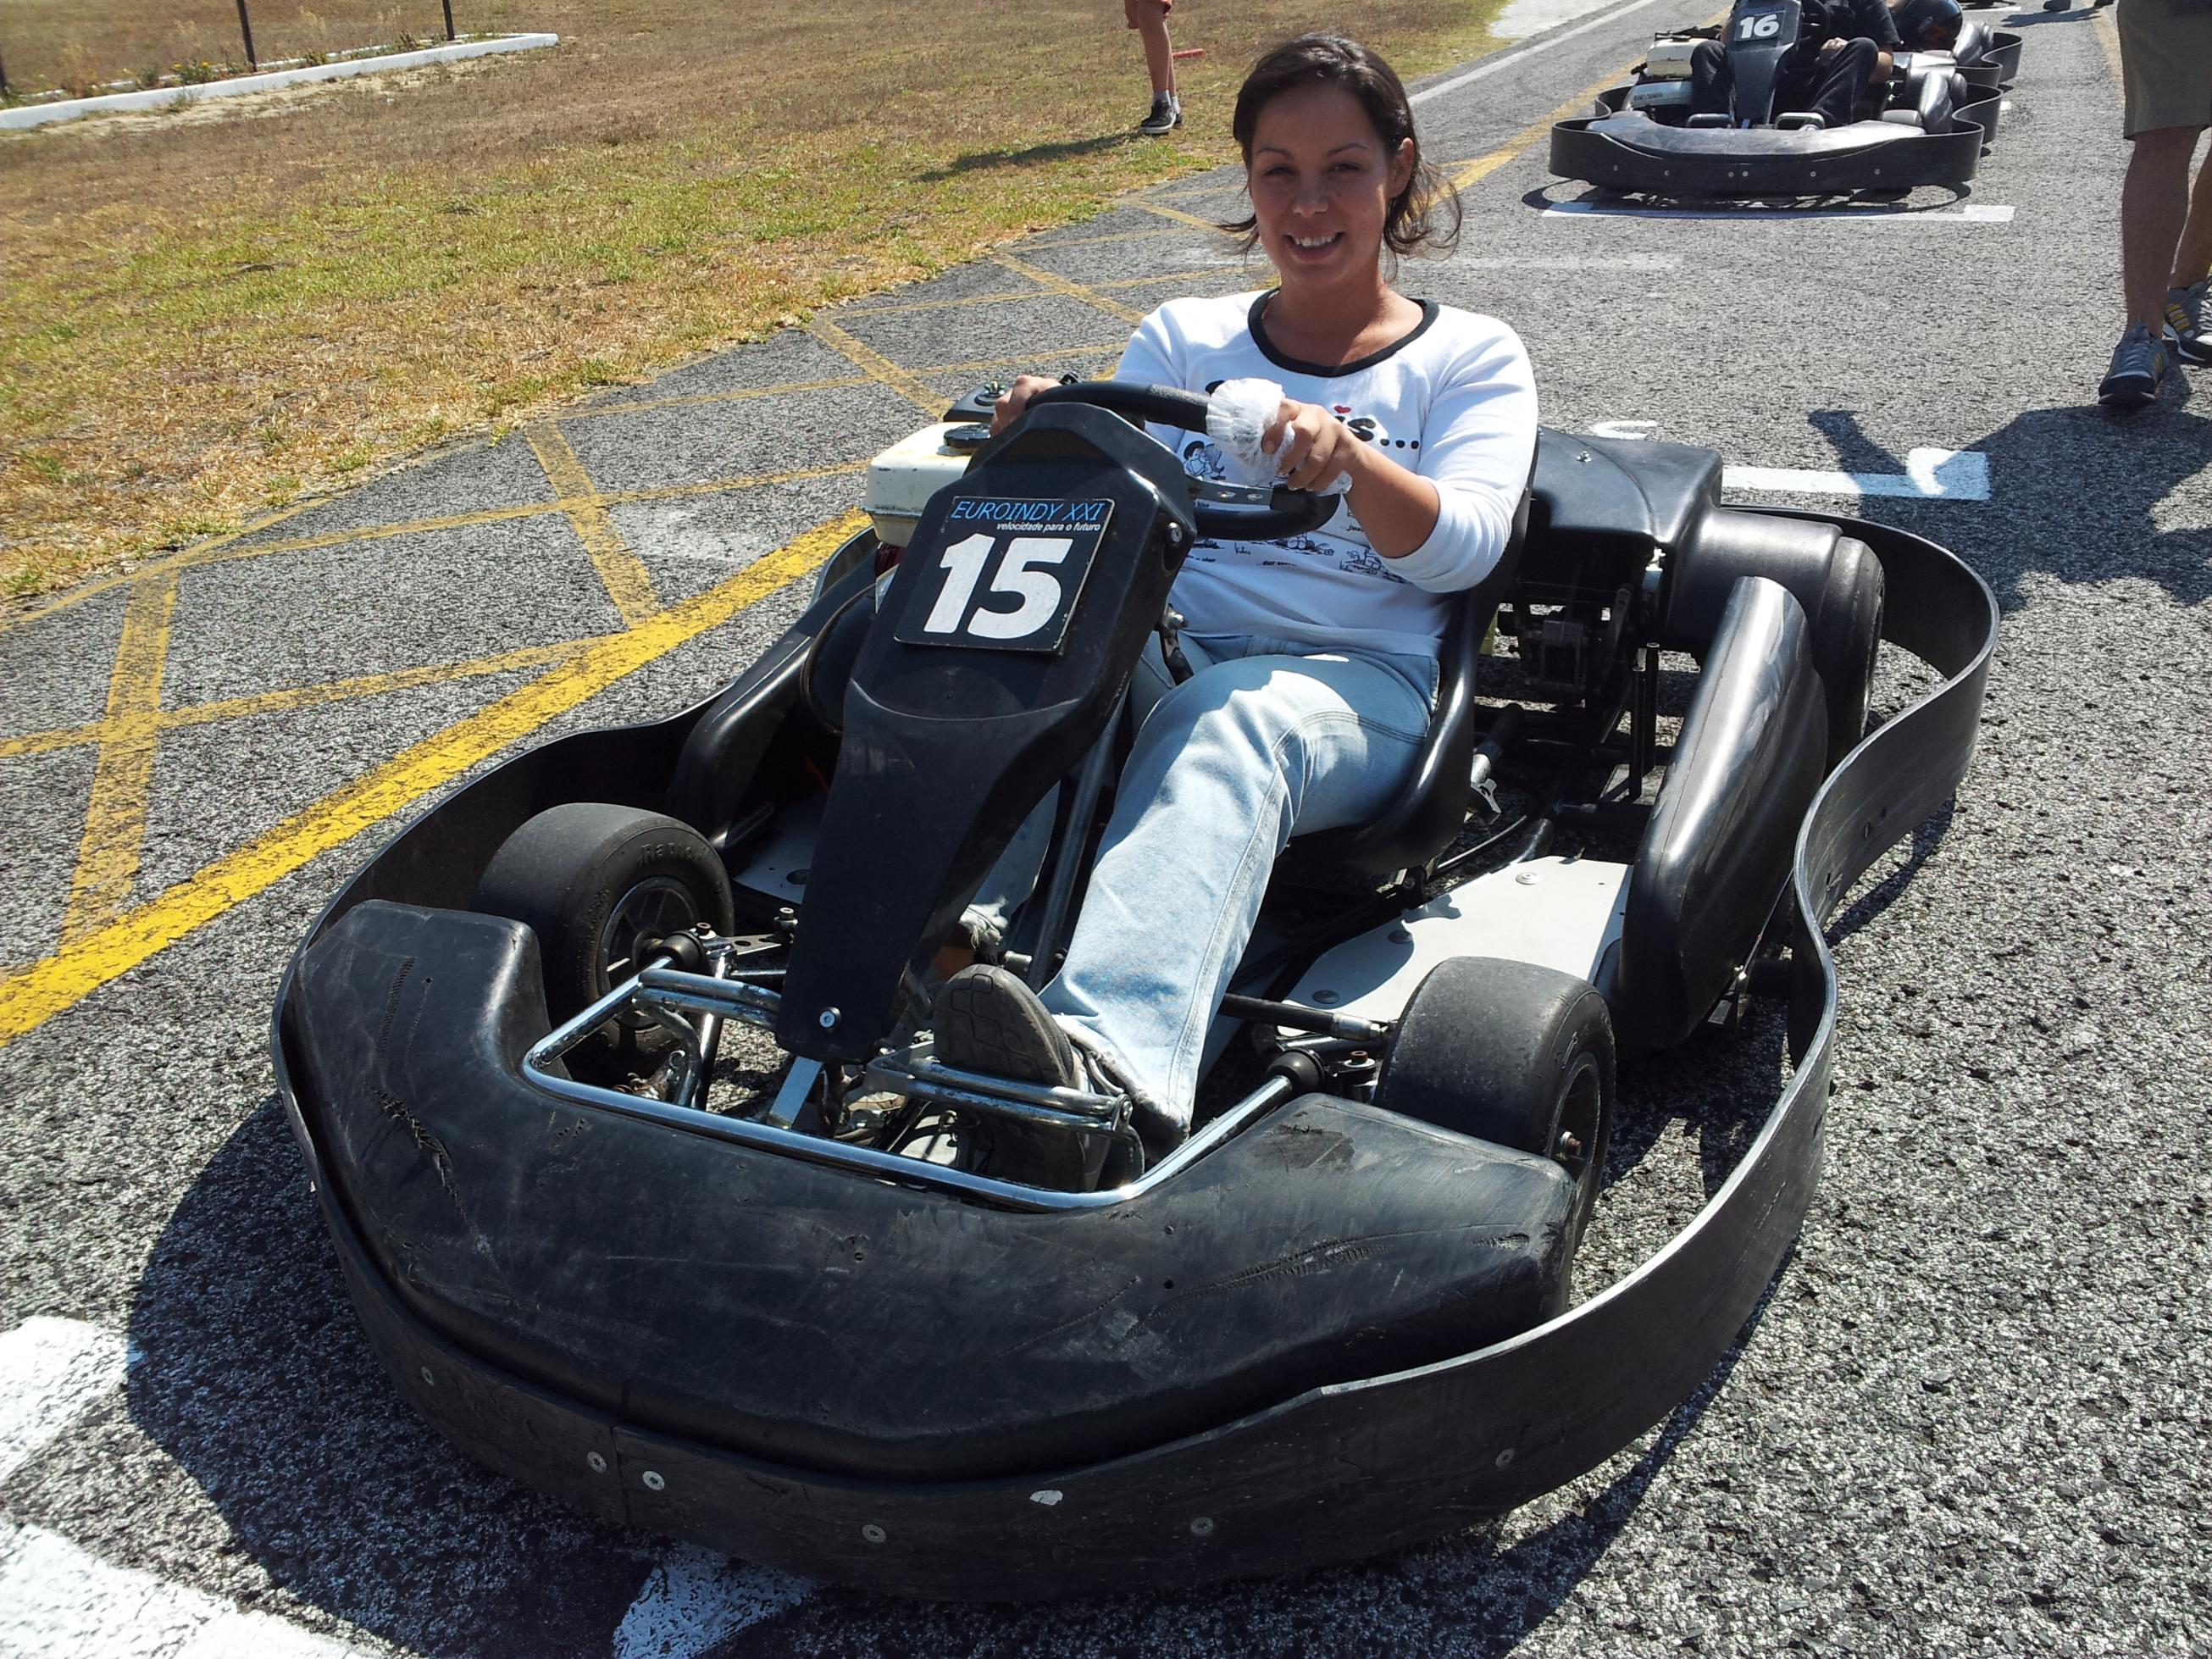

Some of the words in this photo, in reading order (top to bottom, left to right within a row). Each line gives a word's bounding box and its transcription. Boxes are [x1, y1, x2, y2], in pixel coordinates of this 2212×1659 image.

[1739, 14, 1780, 40] 16
[951, 501, 1061, 521] EUROINDY
[1062, 502, 1105, 521] XXI
[996, 522, 1042, 531] velocidade
[1043, 523, 1064, 532] para
[1073, 522, 1101, 532] futuro
[923, 533, 1074, 640] 15
